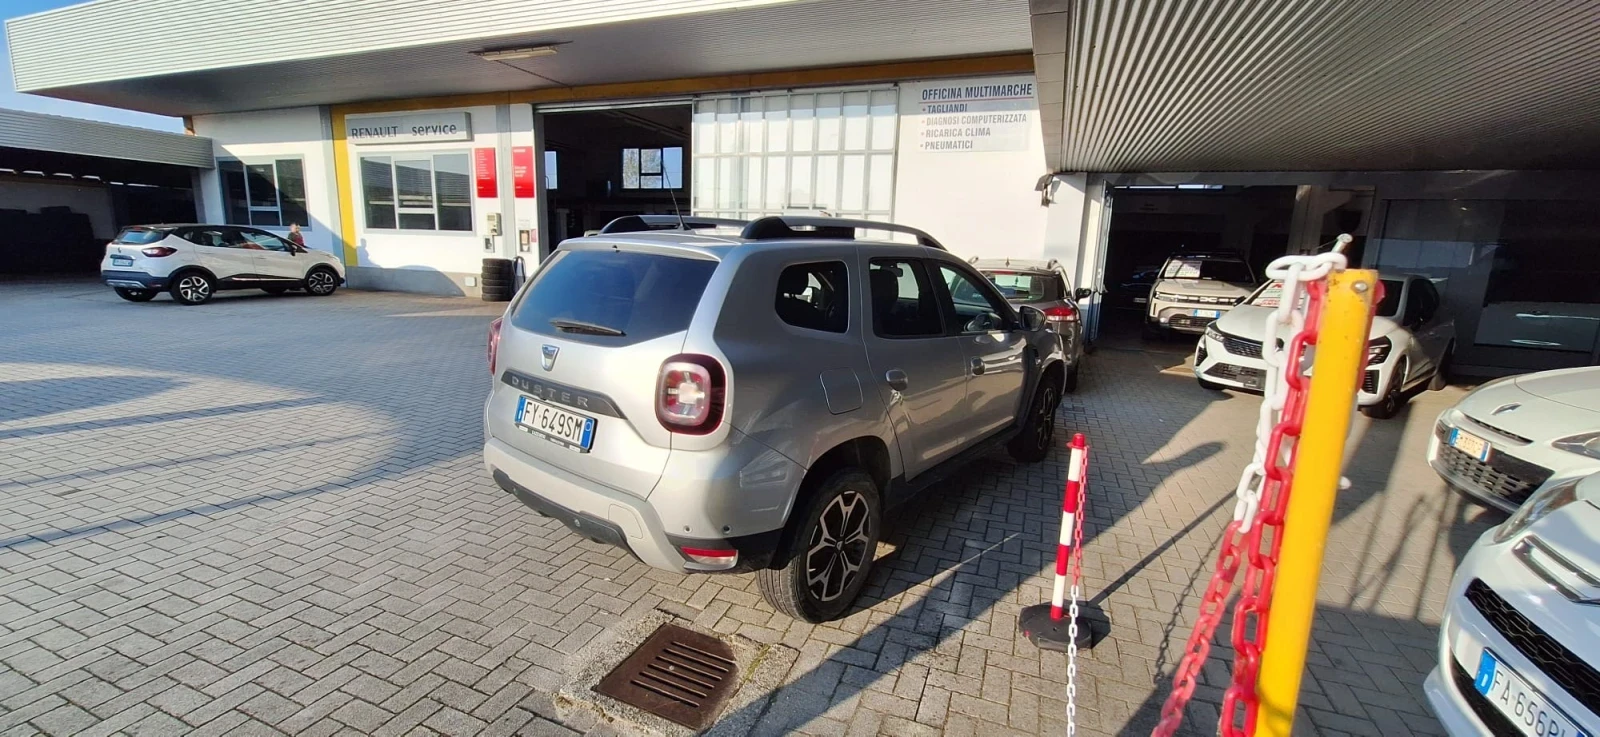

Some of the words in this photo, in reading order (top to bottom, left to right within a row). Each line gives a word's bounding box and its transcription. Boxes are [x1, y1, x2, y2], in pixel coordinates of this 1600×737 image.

[922, 87, 962, 100] OFFICINA
[965, 83, 1032, 98] MULTIMARCHE
[927, 104, 968, 114] TAGLIANDI
[926, 117, 960, 126] DIAGNOSI
[961, 113, 1027, 125] COMPUTERIZZATA
[351, 126, 398, 138] RENAULT
[411, 124, 457, 137] service
[925, 129, 963, 138] RICARICA
[965, 127, 991, 137] CLIMA
[925, 140, 973, 150] PNEUMATICI
[512, 376, 588, 407] DUSTER
[524, 401, 539, 424] FY
[541, 408, 583, 441] 649SM
